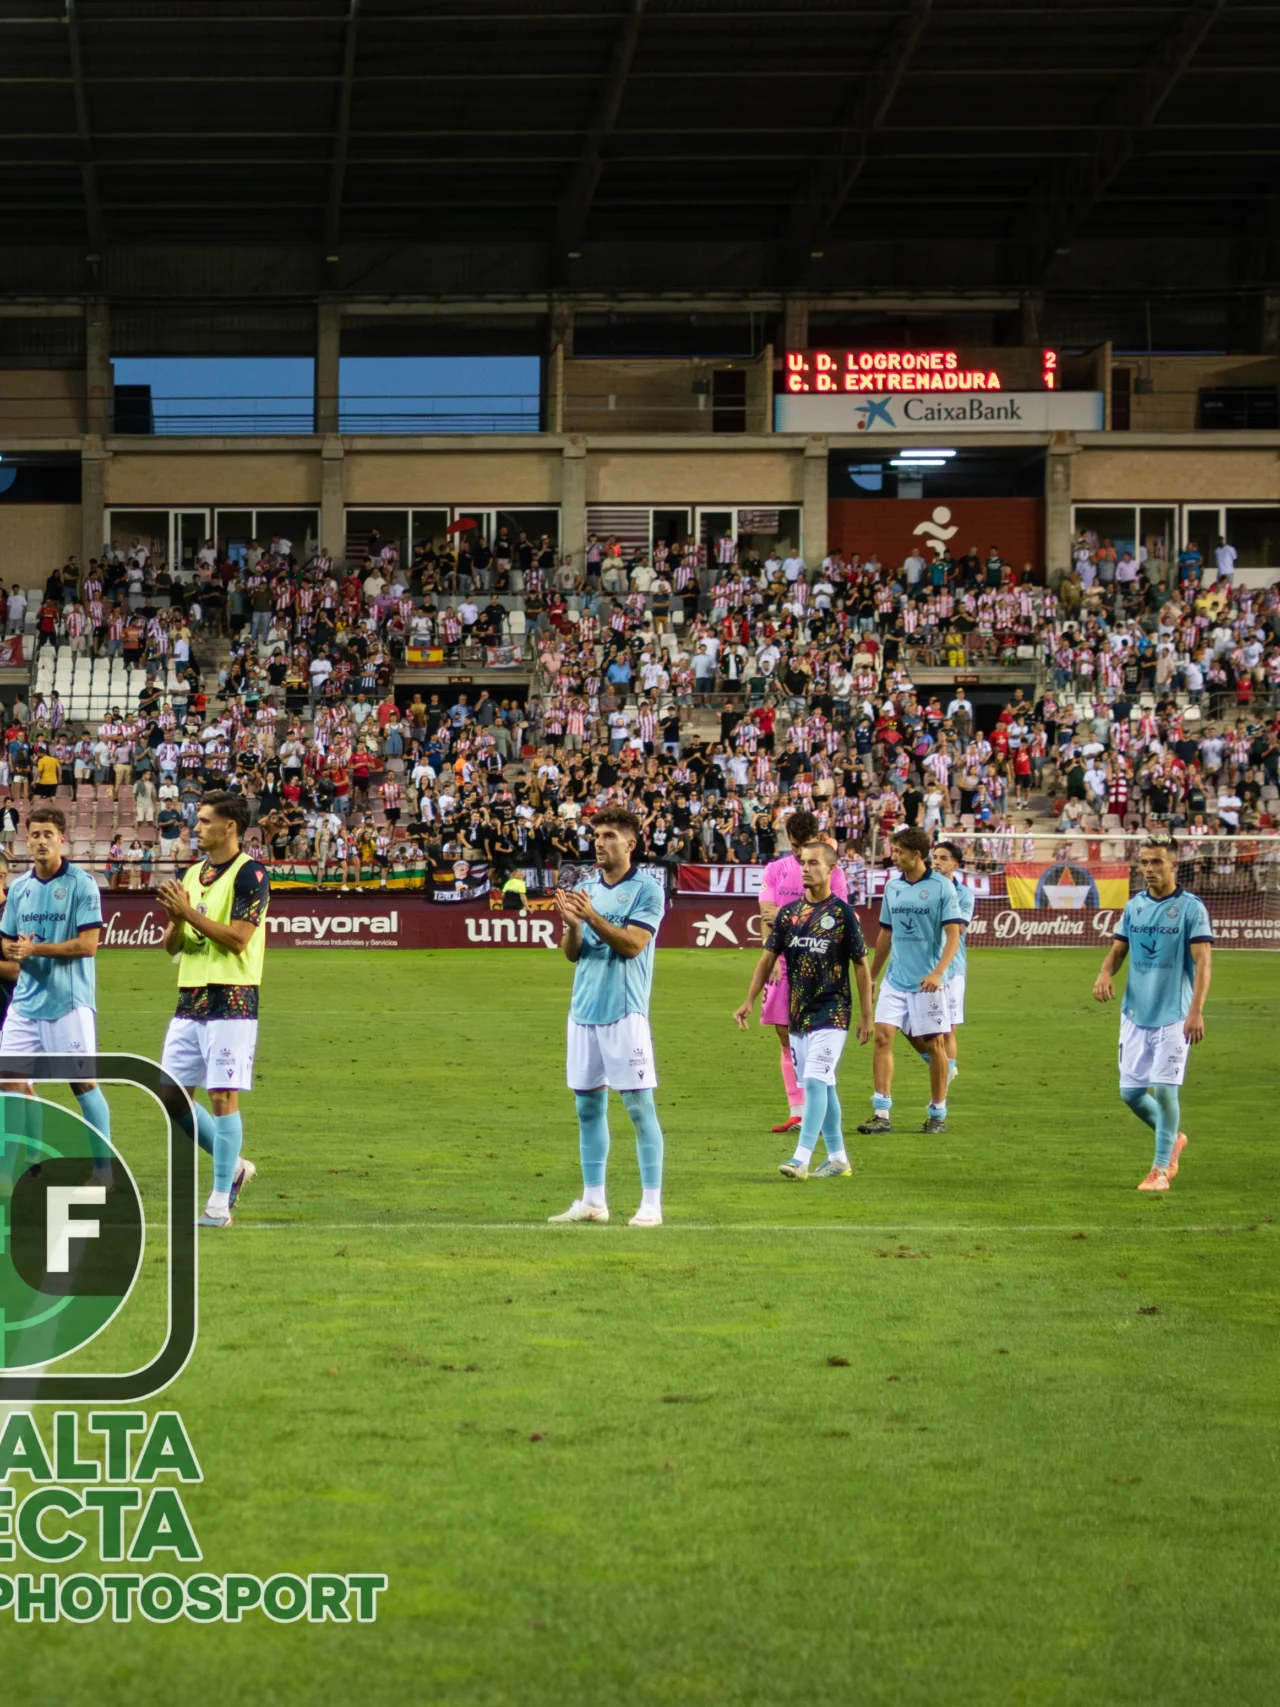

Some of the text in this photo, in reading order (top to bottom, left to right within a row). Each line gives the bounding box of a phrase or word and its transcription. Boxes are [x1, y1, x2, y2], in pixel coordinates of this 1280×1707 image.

[788, 351, 1057, 371] U. D. LOGROÑES 2
[788, 372, 1055, 391] C. D. EXTREMADURA 1
[903, 398, 1023, 421] CaixaBank
[21, 910, 66, 925] telepizza
[891, 905, 930, 917] telepizza
[265, 911, 399, 939] mayoral
[994, 910, 1086, 941] Deportiva
[1130, 924, 1180, 937] telepizza
[1212, 929, 1239, 938] LAS
[295, 938, 329, 946] Suministros
[331, 938, 364, 946] Industriales
[370, 938, 399, 946] Servicios
[788, 935, 831, 950] ACTIVE
